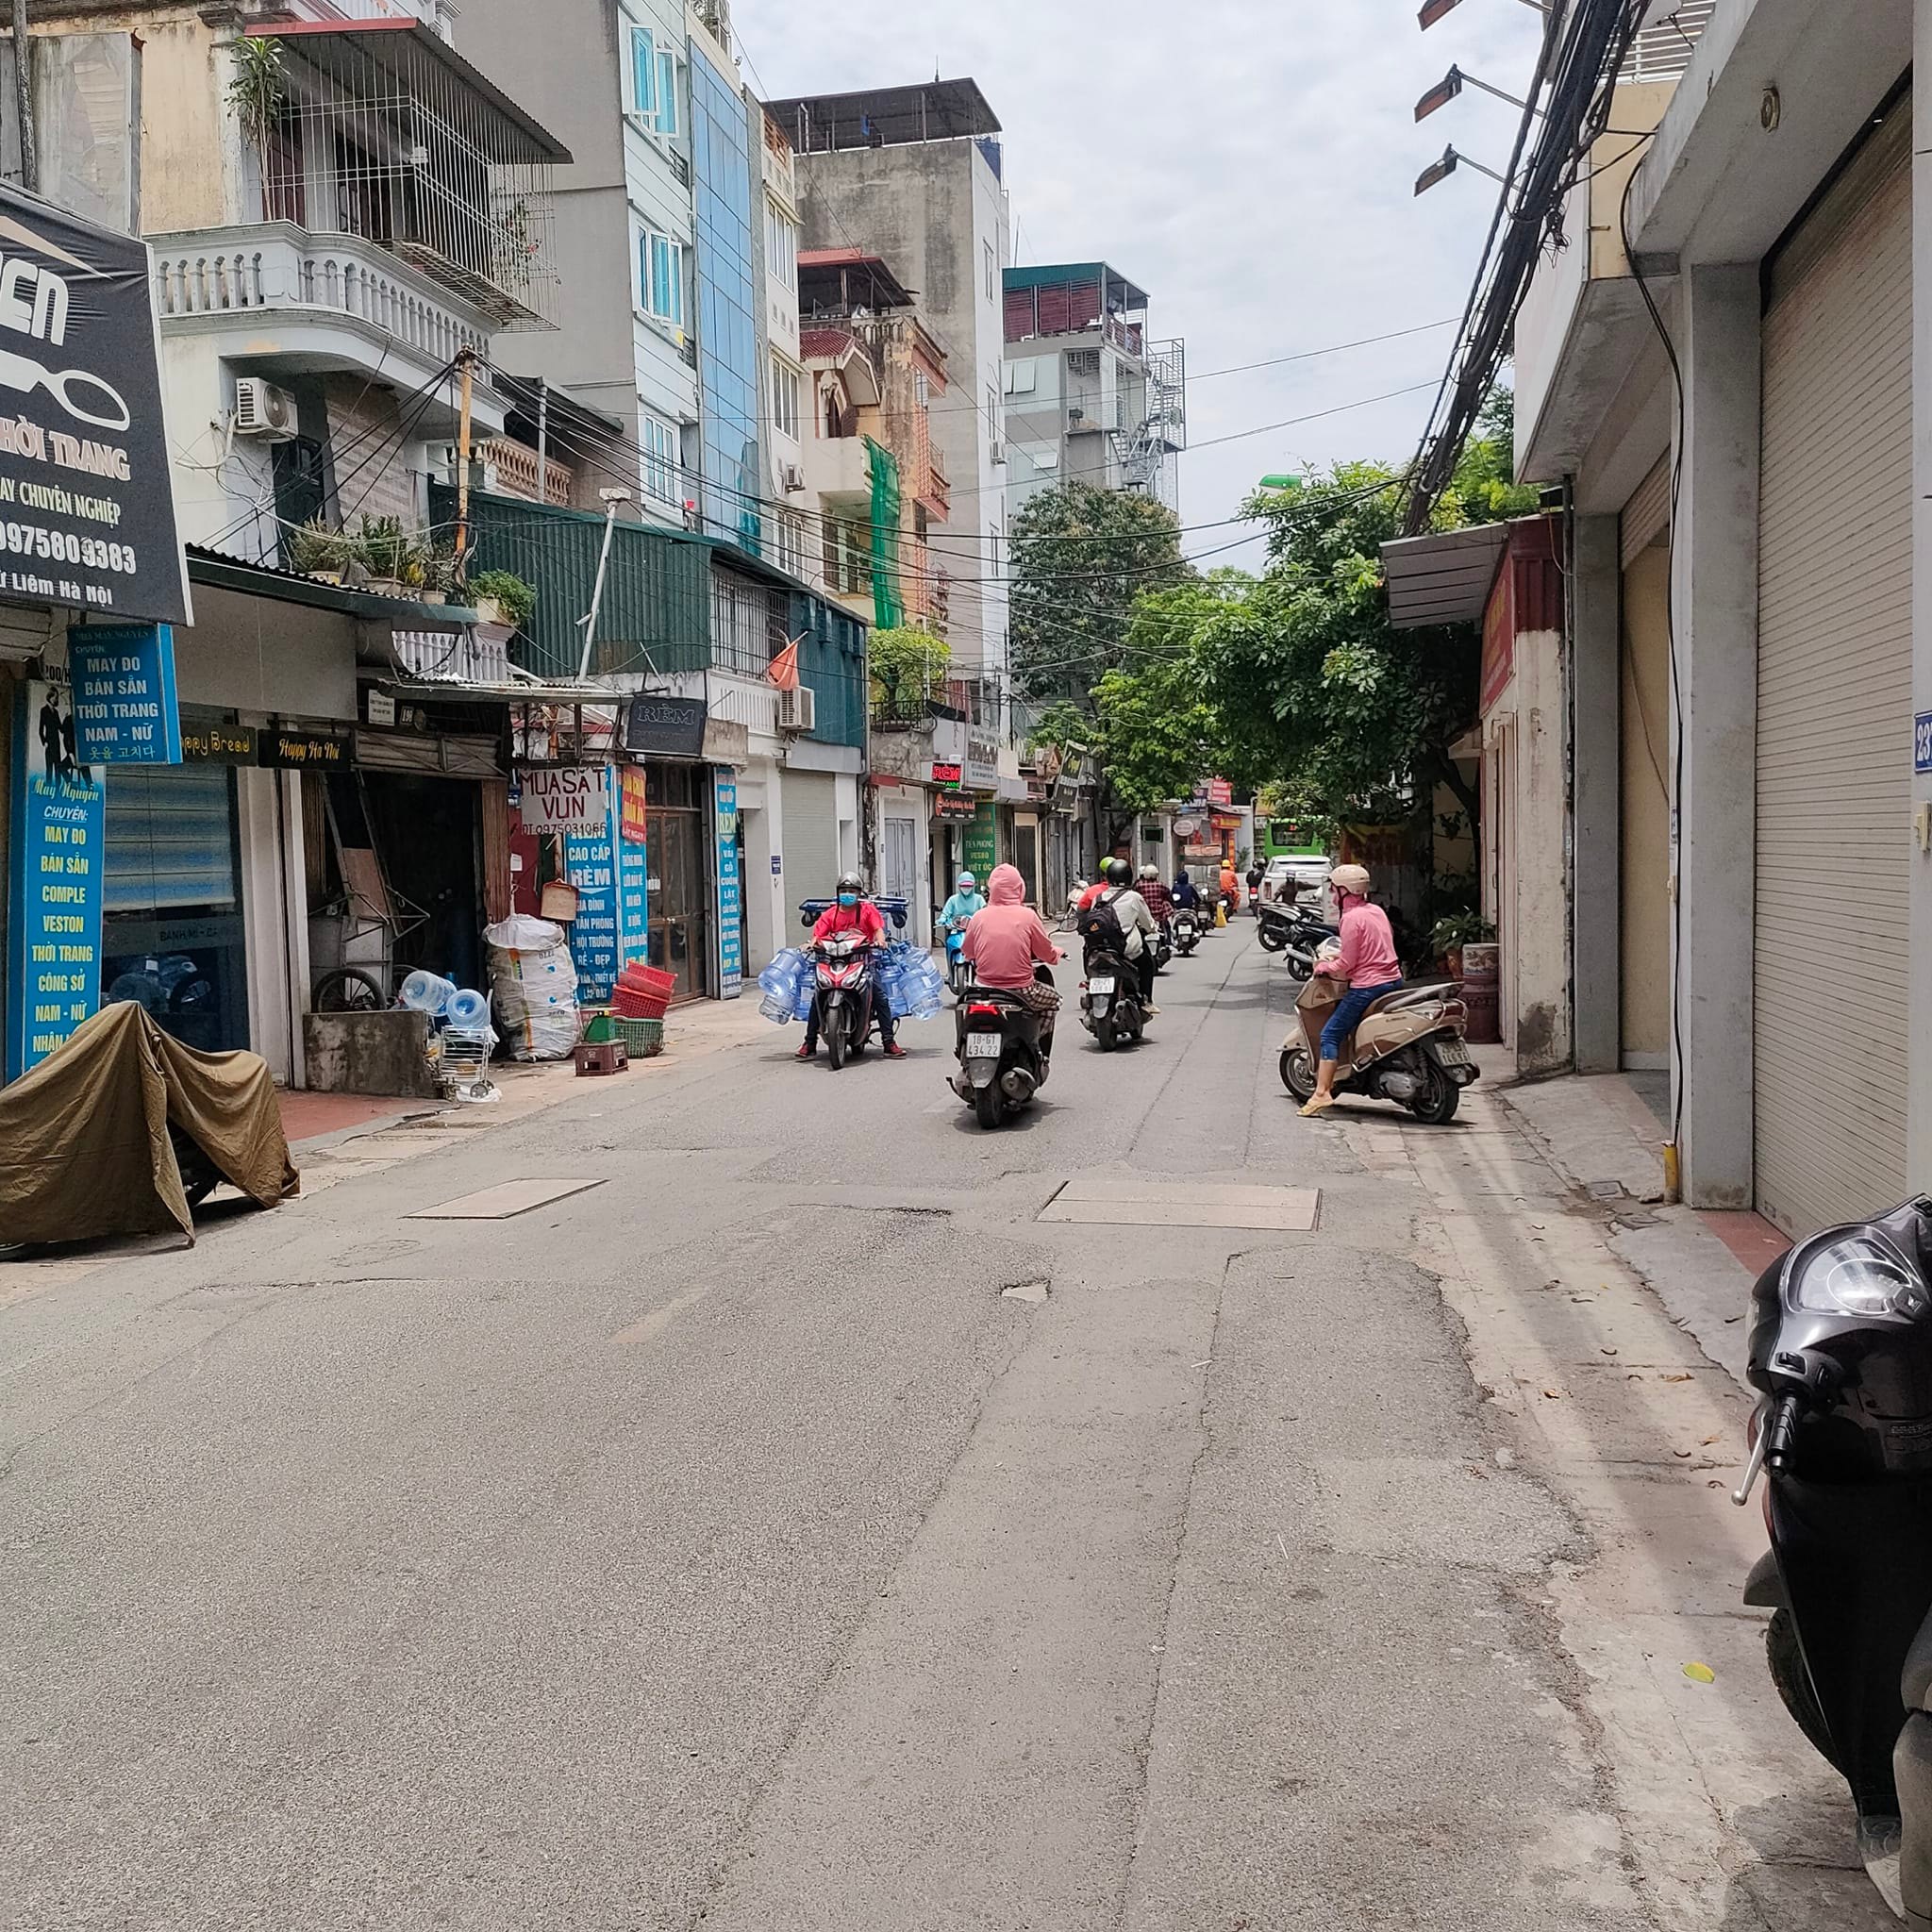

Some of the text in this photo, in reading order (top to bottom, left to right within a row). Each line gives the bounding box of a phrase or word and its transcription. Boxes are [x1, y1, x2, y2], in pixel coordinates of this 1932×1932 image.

[0, 415, 131, 481] HỜI TRANG
[0, 477, 121, 529] AY CHUYÊN NGHIỆP
[12, 573, 54, 595] Liêm
[59, 580, 81, 600] Hà
[87, 657, 141, 673] MAY ĐO
[85, 678, 114, 695] BÁN
[76, 701, 158, 719] THỜI TRANG
[637, 703, 695, 726] RÈM
[85, 727, 119, 741] NAM
[131, 723, 154, 741] NỮ
[210, 731, 250, 753] Bread
[1916, 723, 1932, 762] 23
[520, 772, 561, 796] MUA
[541, 795, 585, 823] VỤN
[44, 825, 87, 845] MAY ĐO
[568, 846, 589, 861] CAO
[591, 841, 611, 861] CẤP
[41, 852, 64, 874] BÁN
[571, 864, 611, 887] RÈM
[42, 885, 87, 905] COMPLE
[42, 915, 84, 933] VESTON
[58, 945, 93, 962] TRANG
[38, 973, 68, 992] CÔNG
[35, 1004, 61, 1023] NAM
